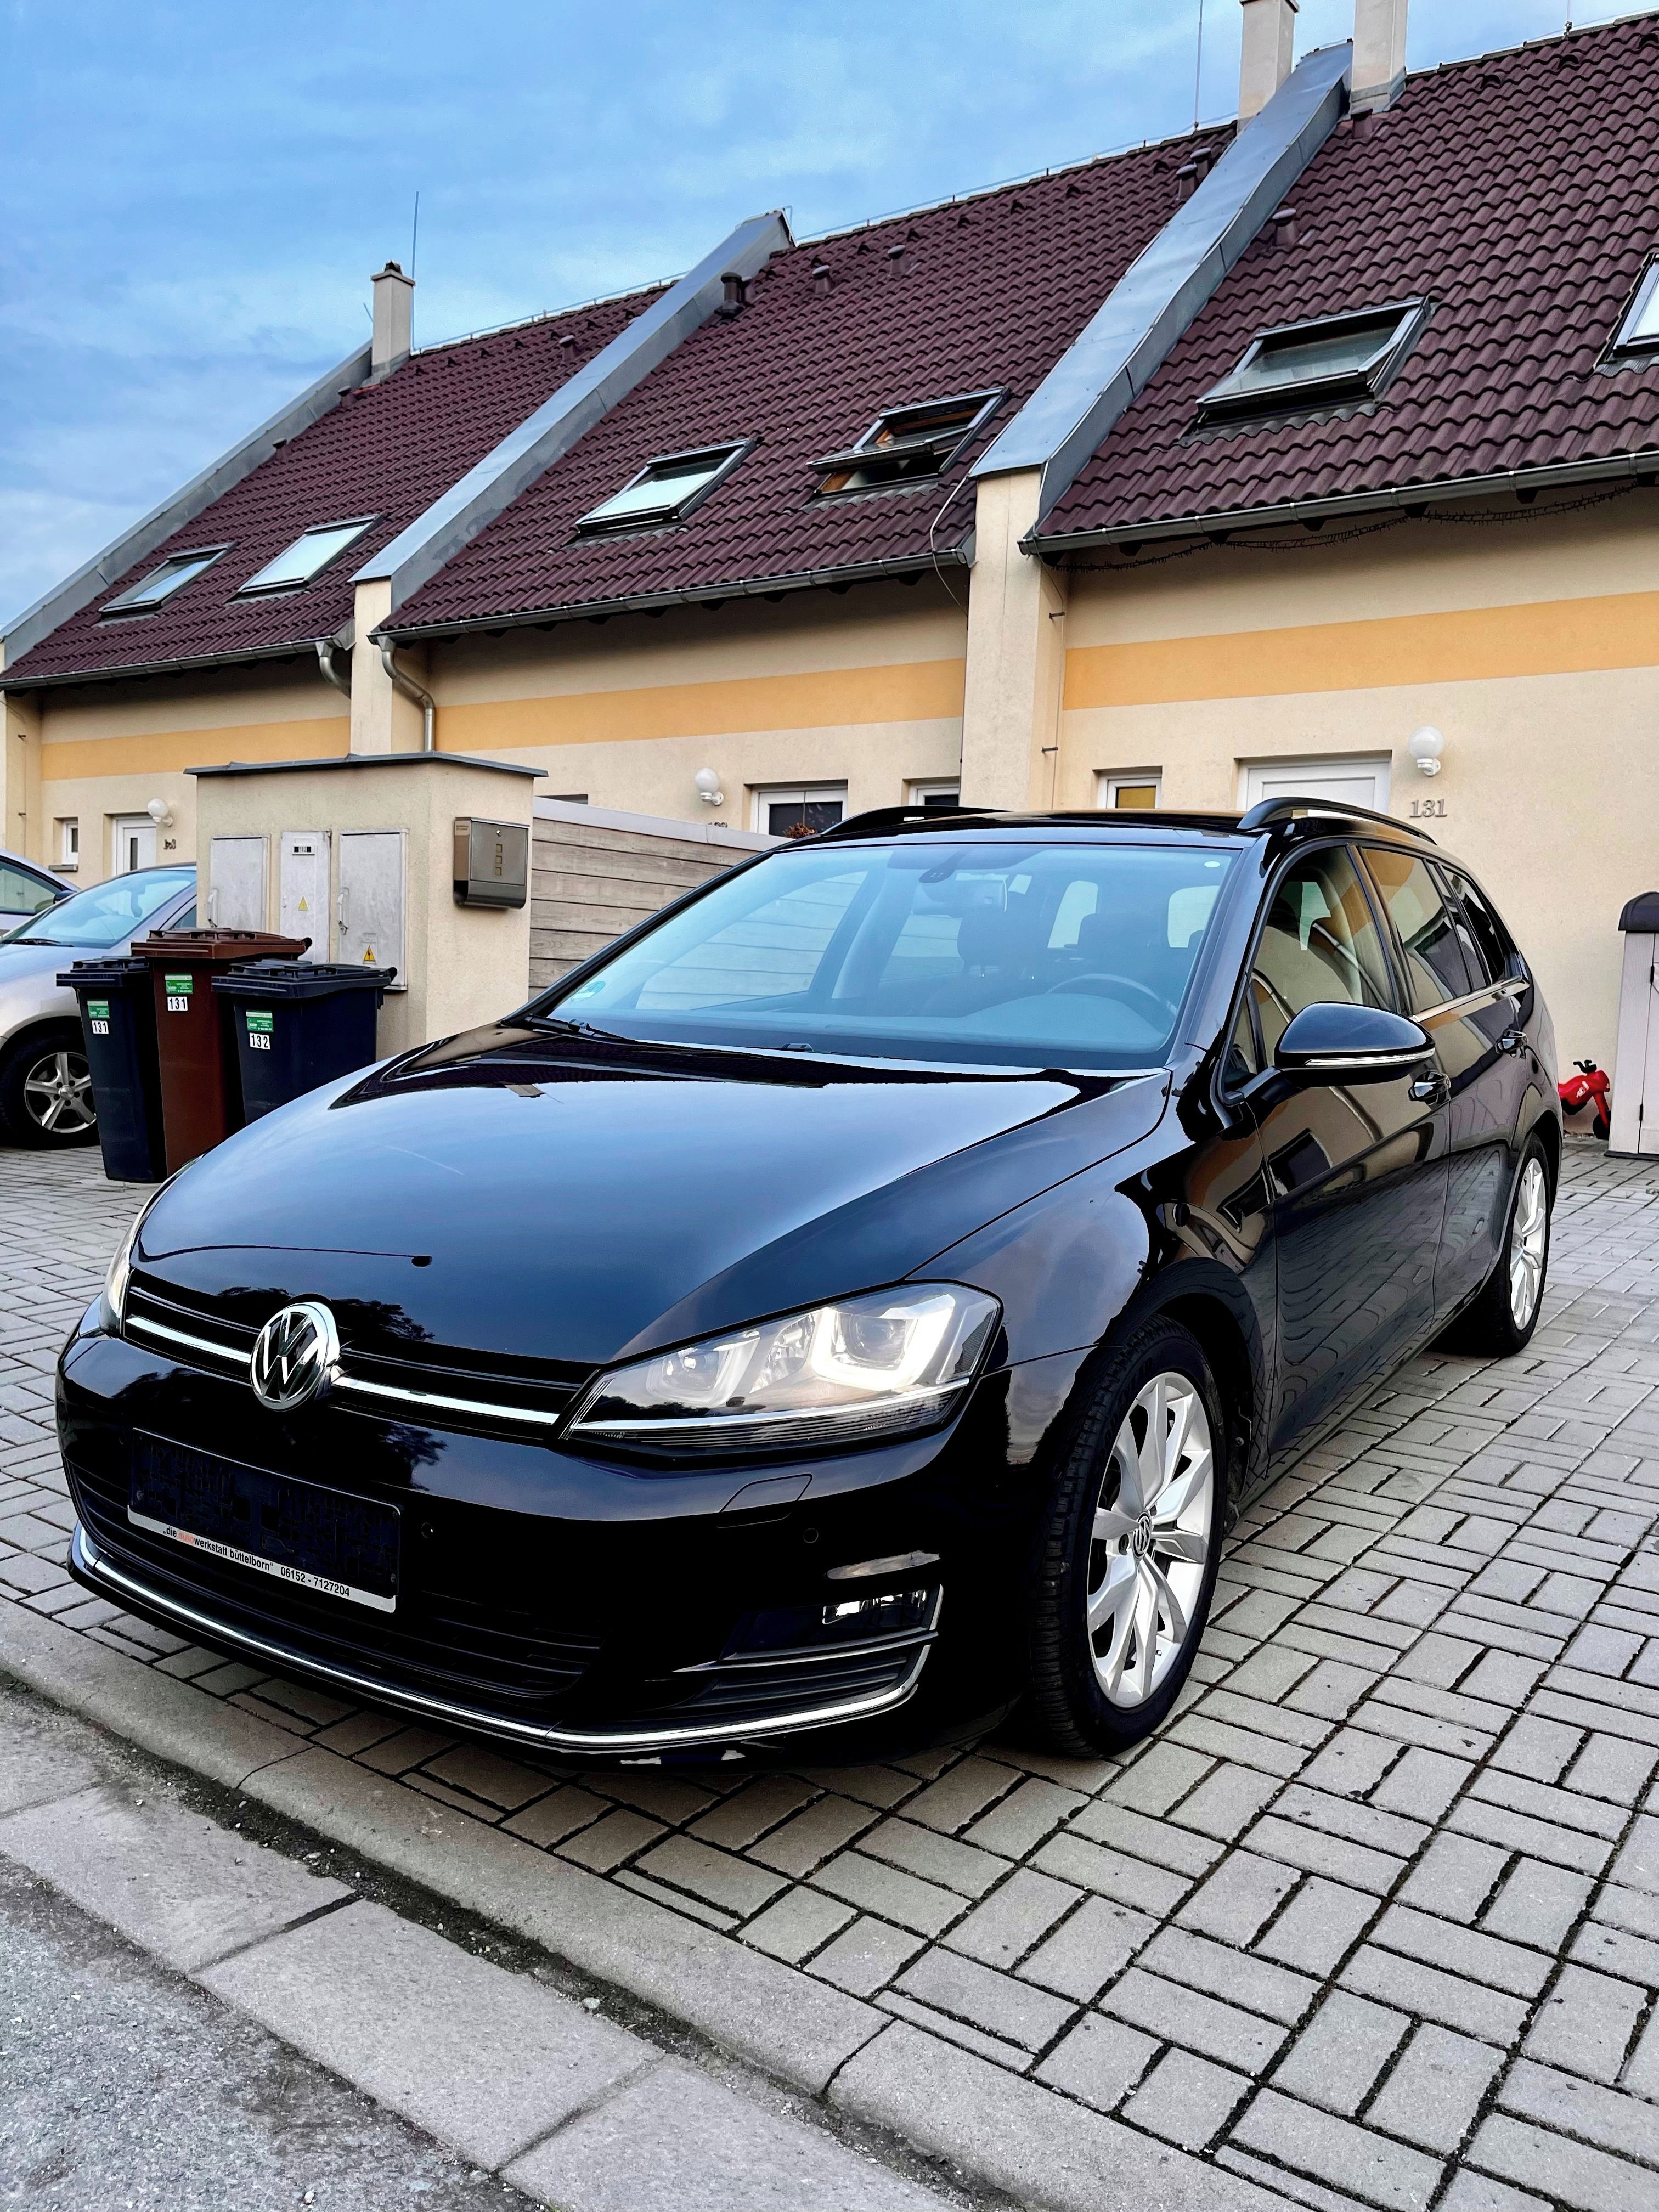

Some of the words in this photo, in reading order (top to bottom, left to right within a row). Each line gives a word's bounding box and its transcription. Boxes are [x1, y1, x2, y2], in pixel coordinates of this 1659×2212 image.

[1409, 799, 1448, 818] 131
[170, 998, 185, 1009] 131
[94, 1022, 107, 1032] 131
[251, 1034, 268, 1048] 132
[280, 1566, 305, 1583] 06152
[313, 1577, 349, 1597] 7127204
